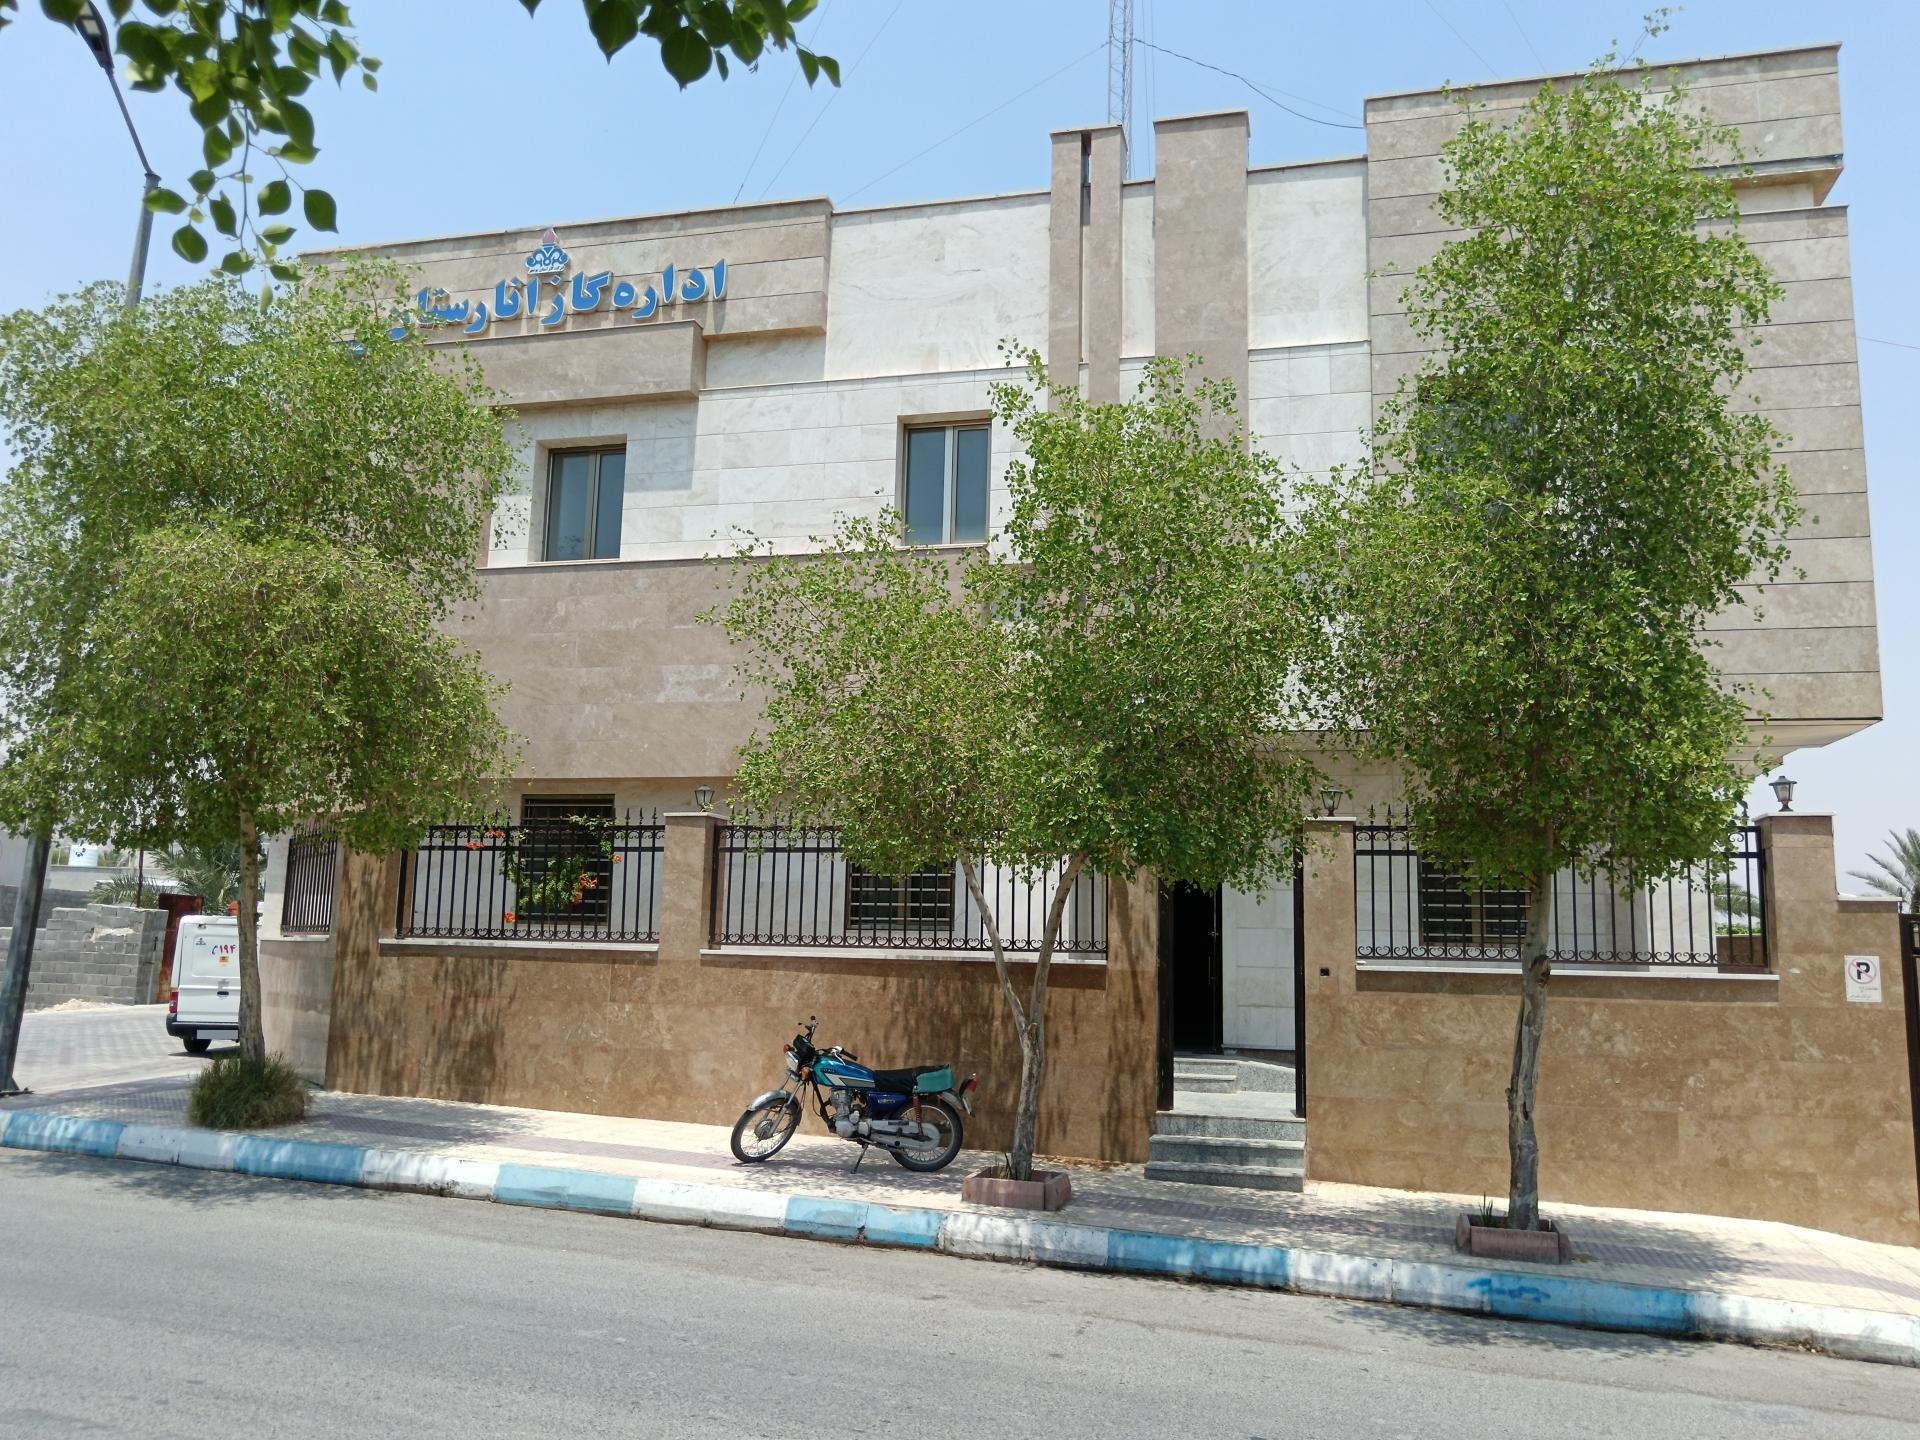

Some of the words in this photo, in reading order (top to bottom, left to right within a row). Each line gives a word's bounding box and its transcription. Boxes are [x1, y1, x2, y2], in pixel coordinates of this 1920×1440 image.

[540, 270, 613, 327] گاز
[612, 258, 728, 319] اداره
[1856, 961, 1871, 980] P
